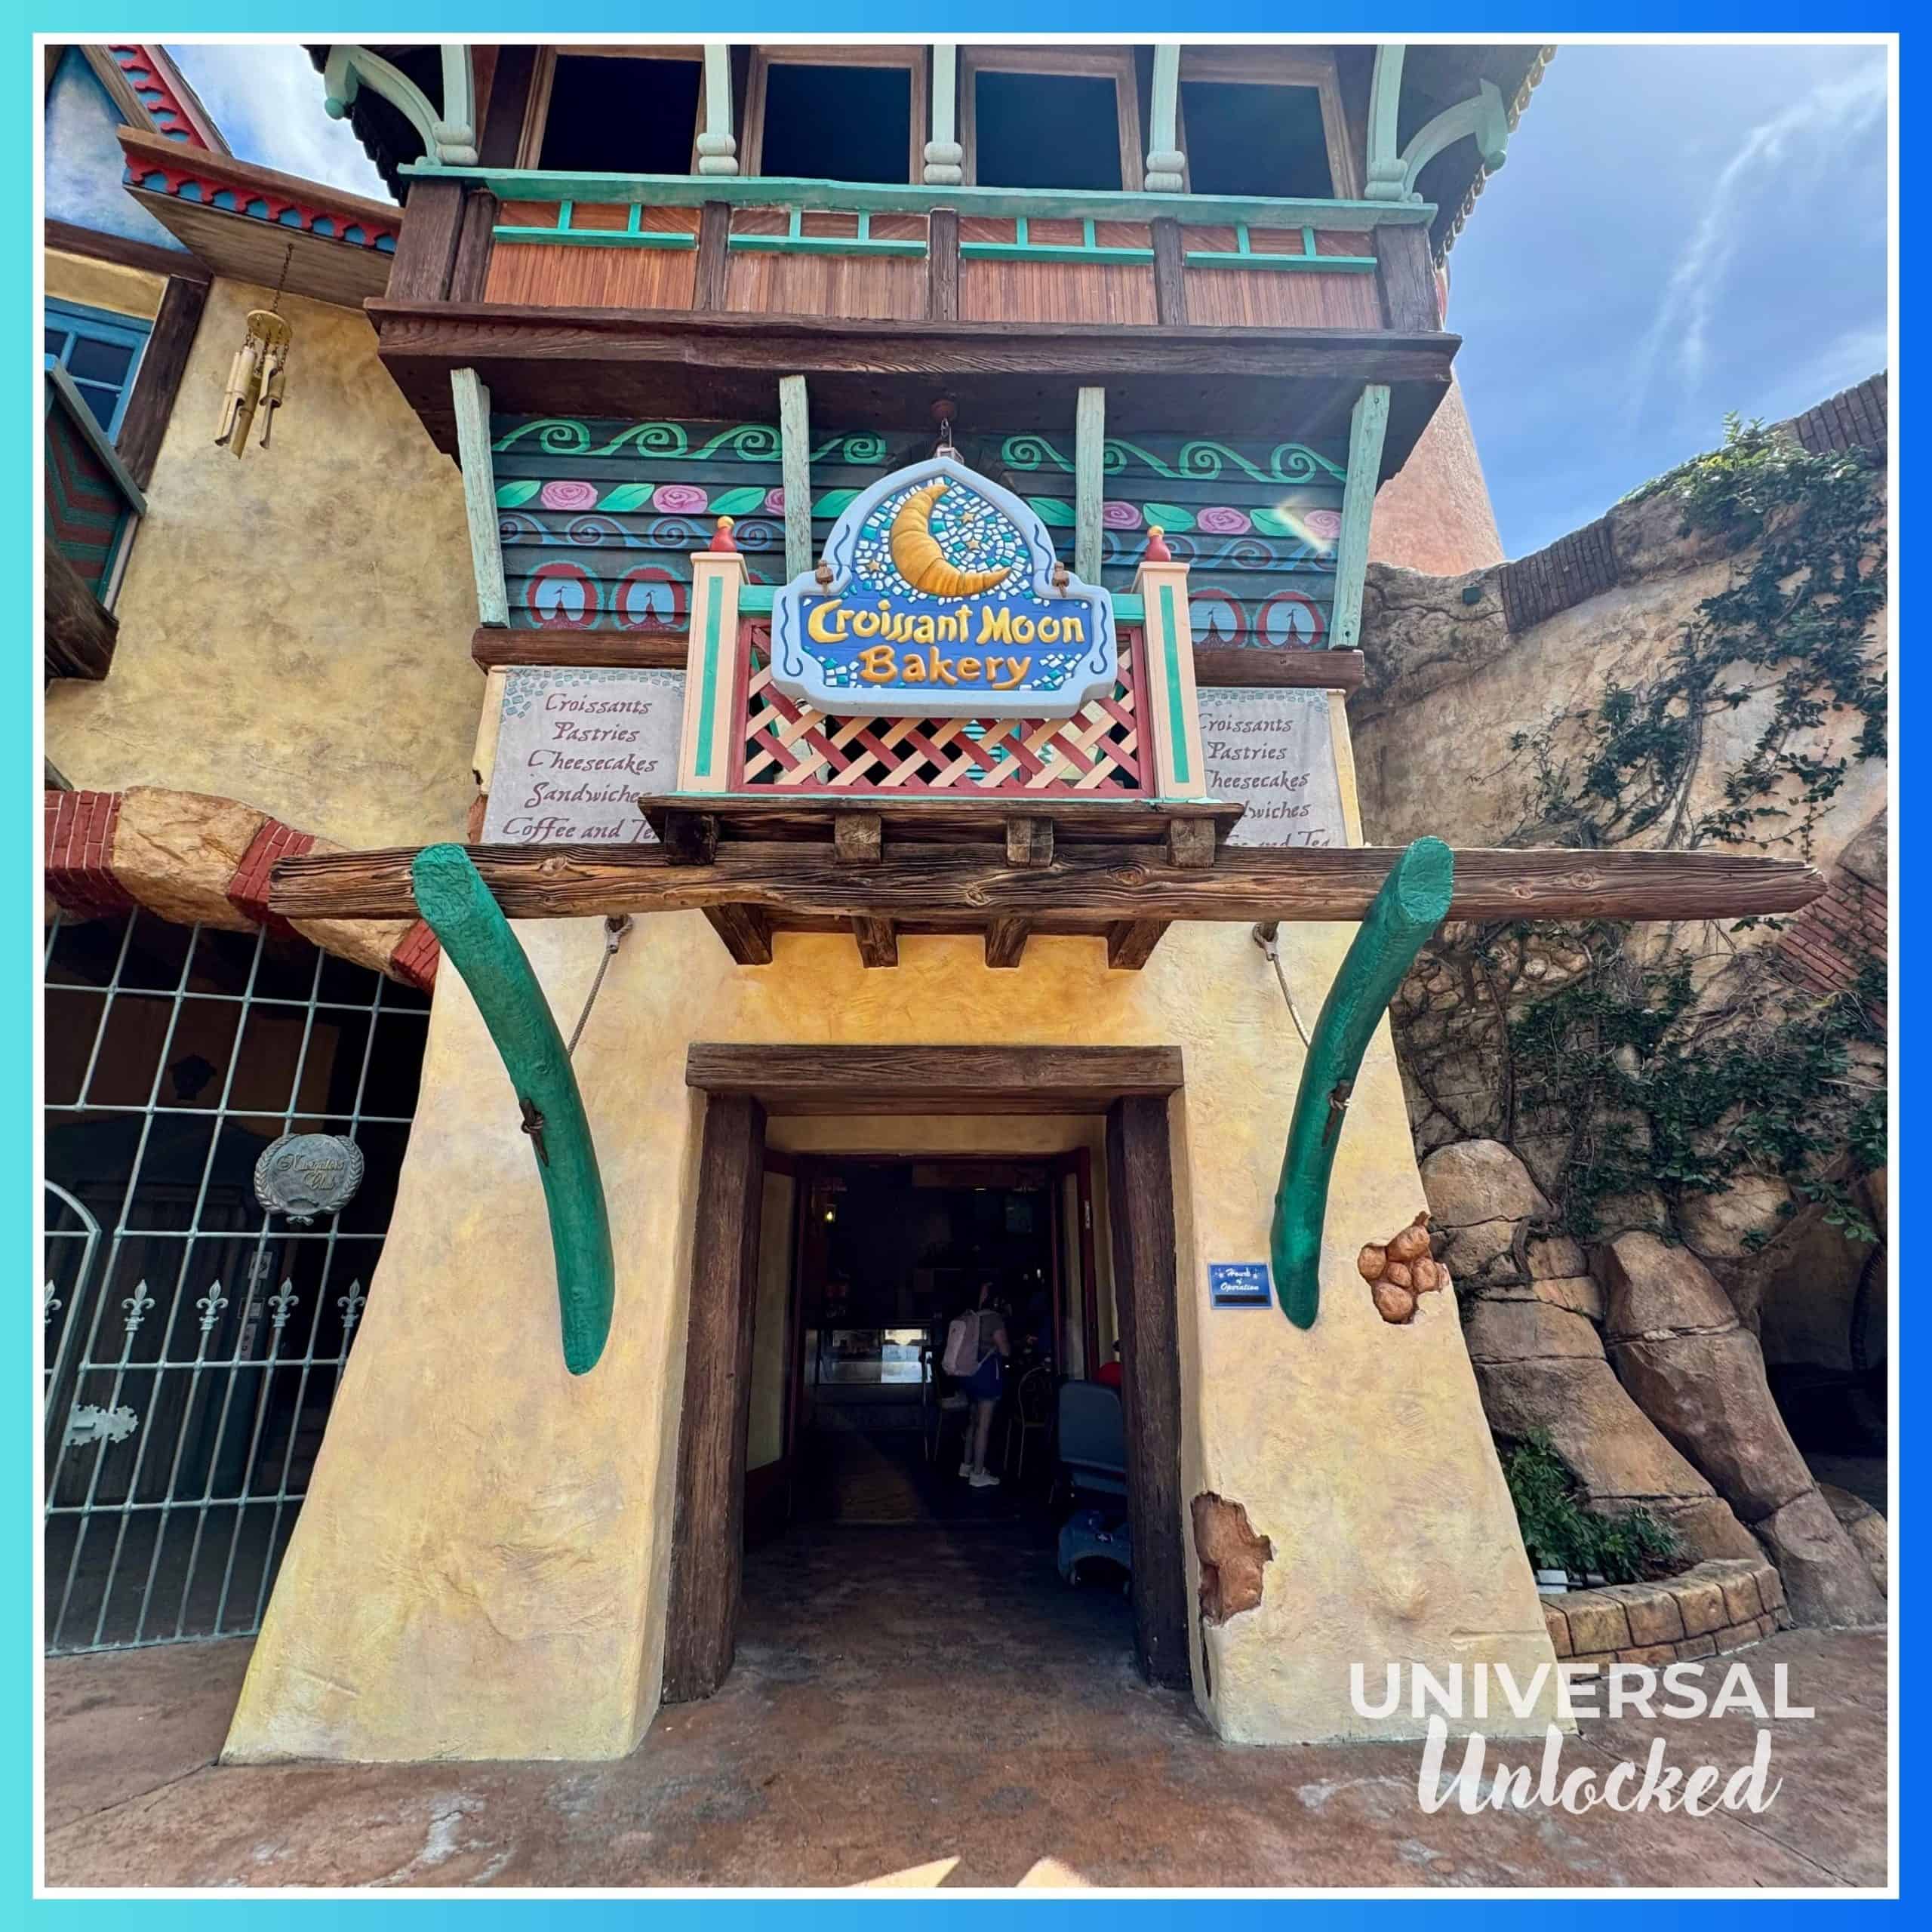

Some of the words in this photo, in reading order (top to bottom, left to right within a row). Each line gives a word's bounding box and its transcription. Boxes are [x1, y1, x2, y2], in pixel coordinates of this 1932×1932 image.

[807, 598, 974, 644] Croissant
[976, 605, 1085, 645] Moon
[858, 645, 1032, 690] Bakery
[545, 692, 653, 714] Croissants
[552, 721, 640, 742] Pastries
[528, 749, 658, 775] Cheesecakes
[1207, 741, 1287, 761] Pastries
[1204, 769, 1311, 792] heesecakes
[524, 782, 653, 808] Sandwiche
[503, 817, 575, 843] Coffee
[580, 818, 626, 838] and
